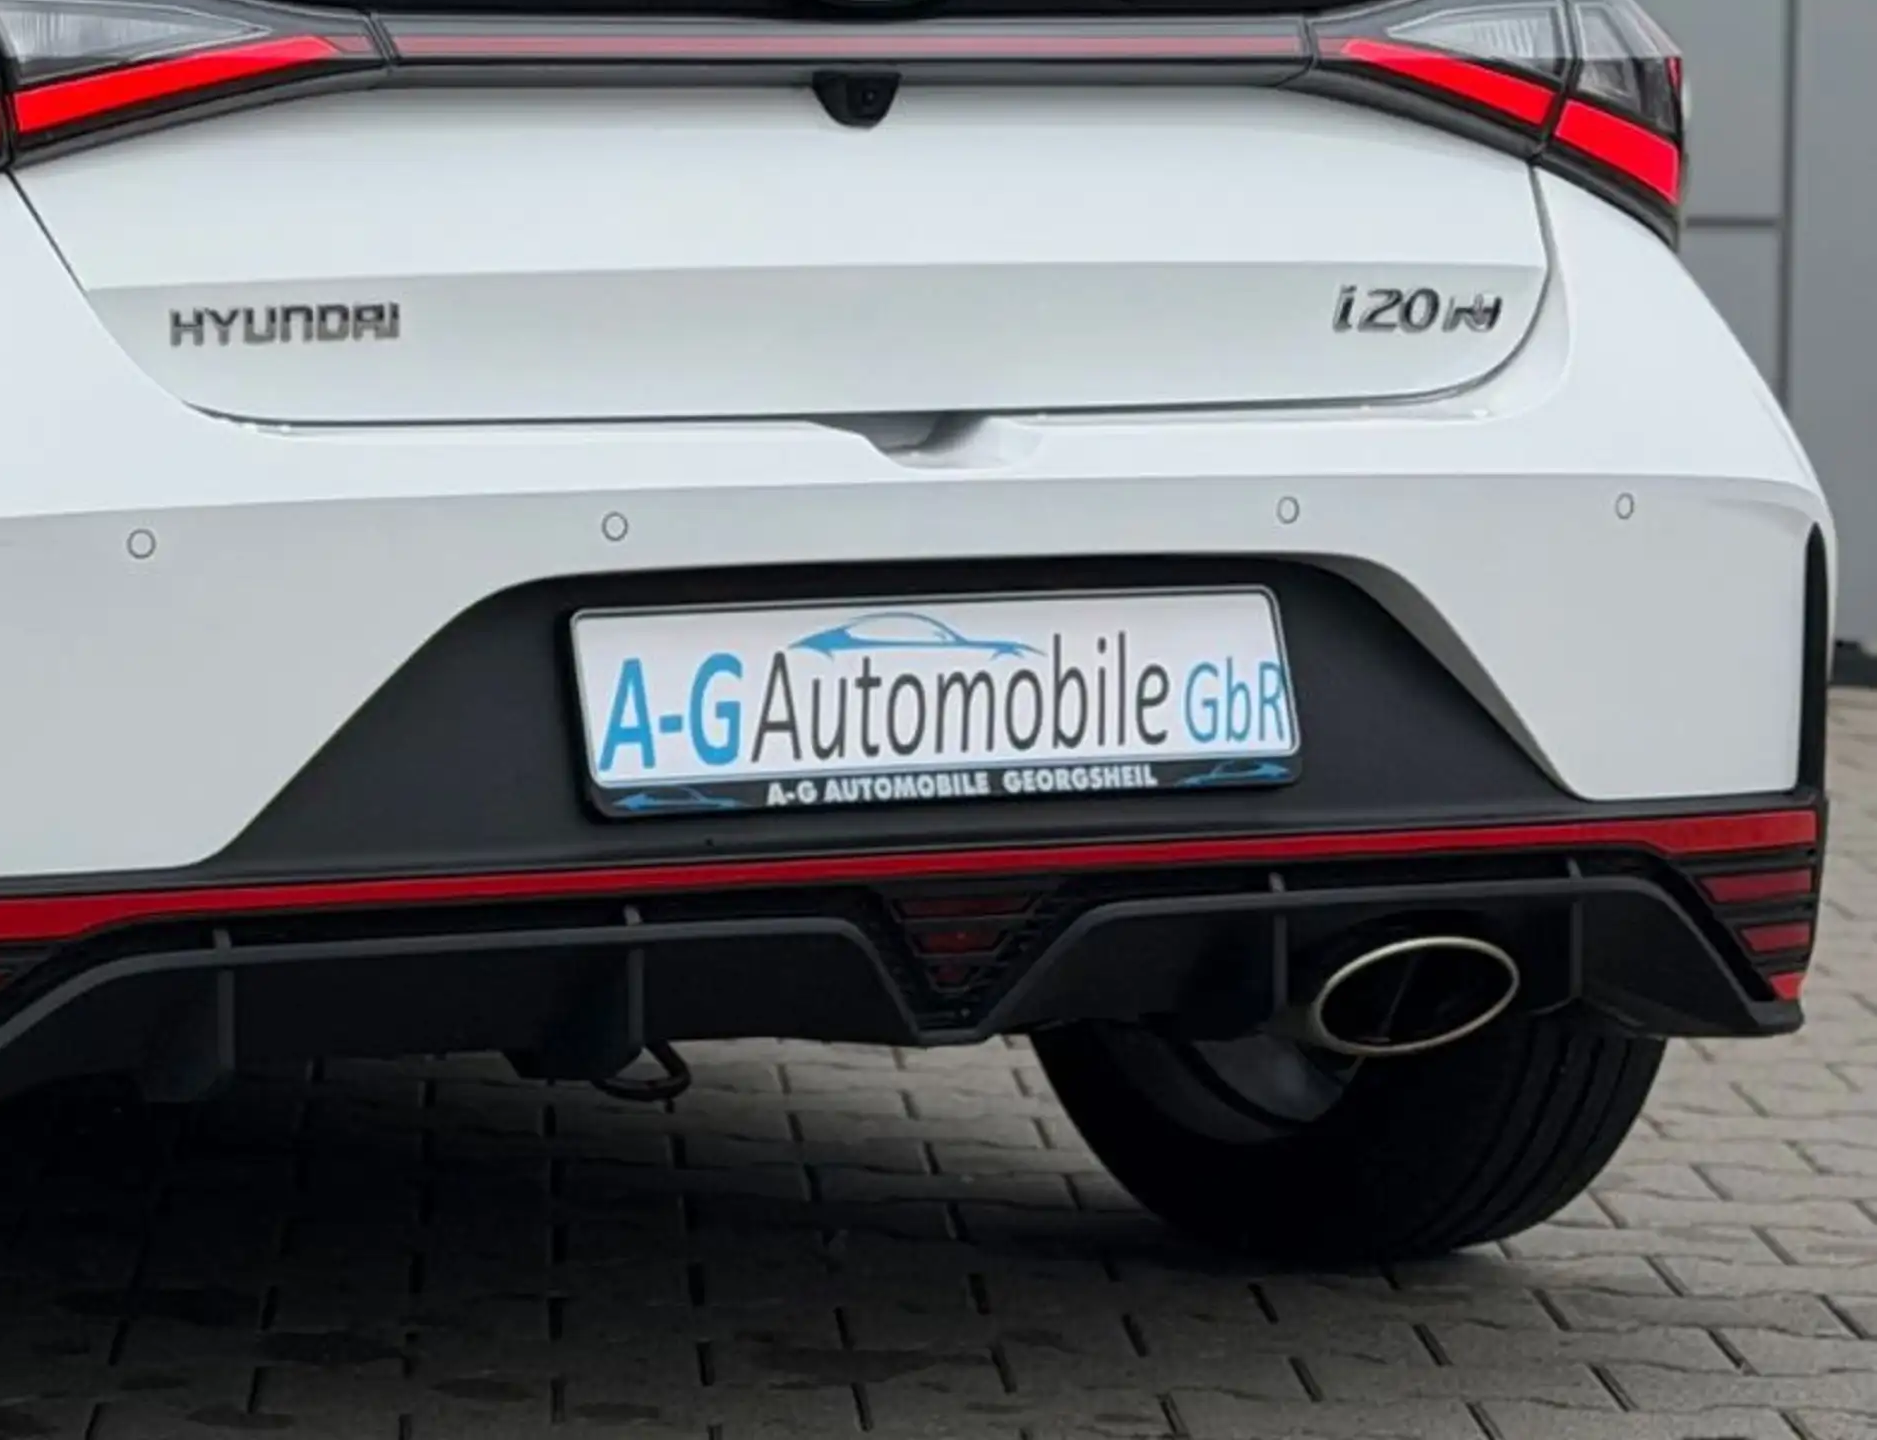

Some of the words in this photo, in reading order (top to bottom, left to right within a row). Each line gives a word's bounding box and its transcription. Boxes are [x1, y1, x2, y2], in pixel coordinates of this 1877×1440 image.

[169, 302, 401, 347] HYUNDAI
[596, 651, 745, 773] A-G
[750, 630, 1171, 764] Automobile
[1184, 655, 1286, 745] GbR
[765, 779, 819, 807] A-G
[822, 770, 992, 804] AUTOMOBILE
[1001, 763, 1159, 794] GEORGSHEIL
